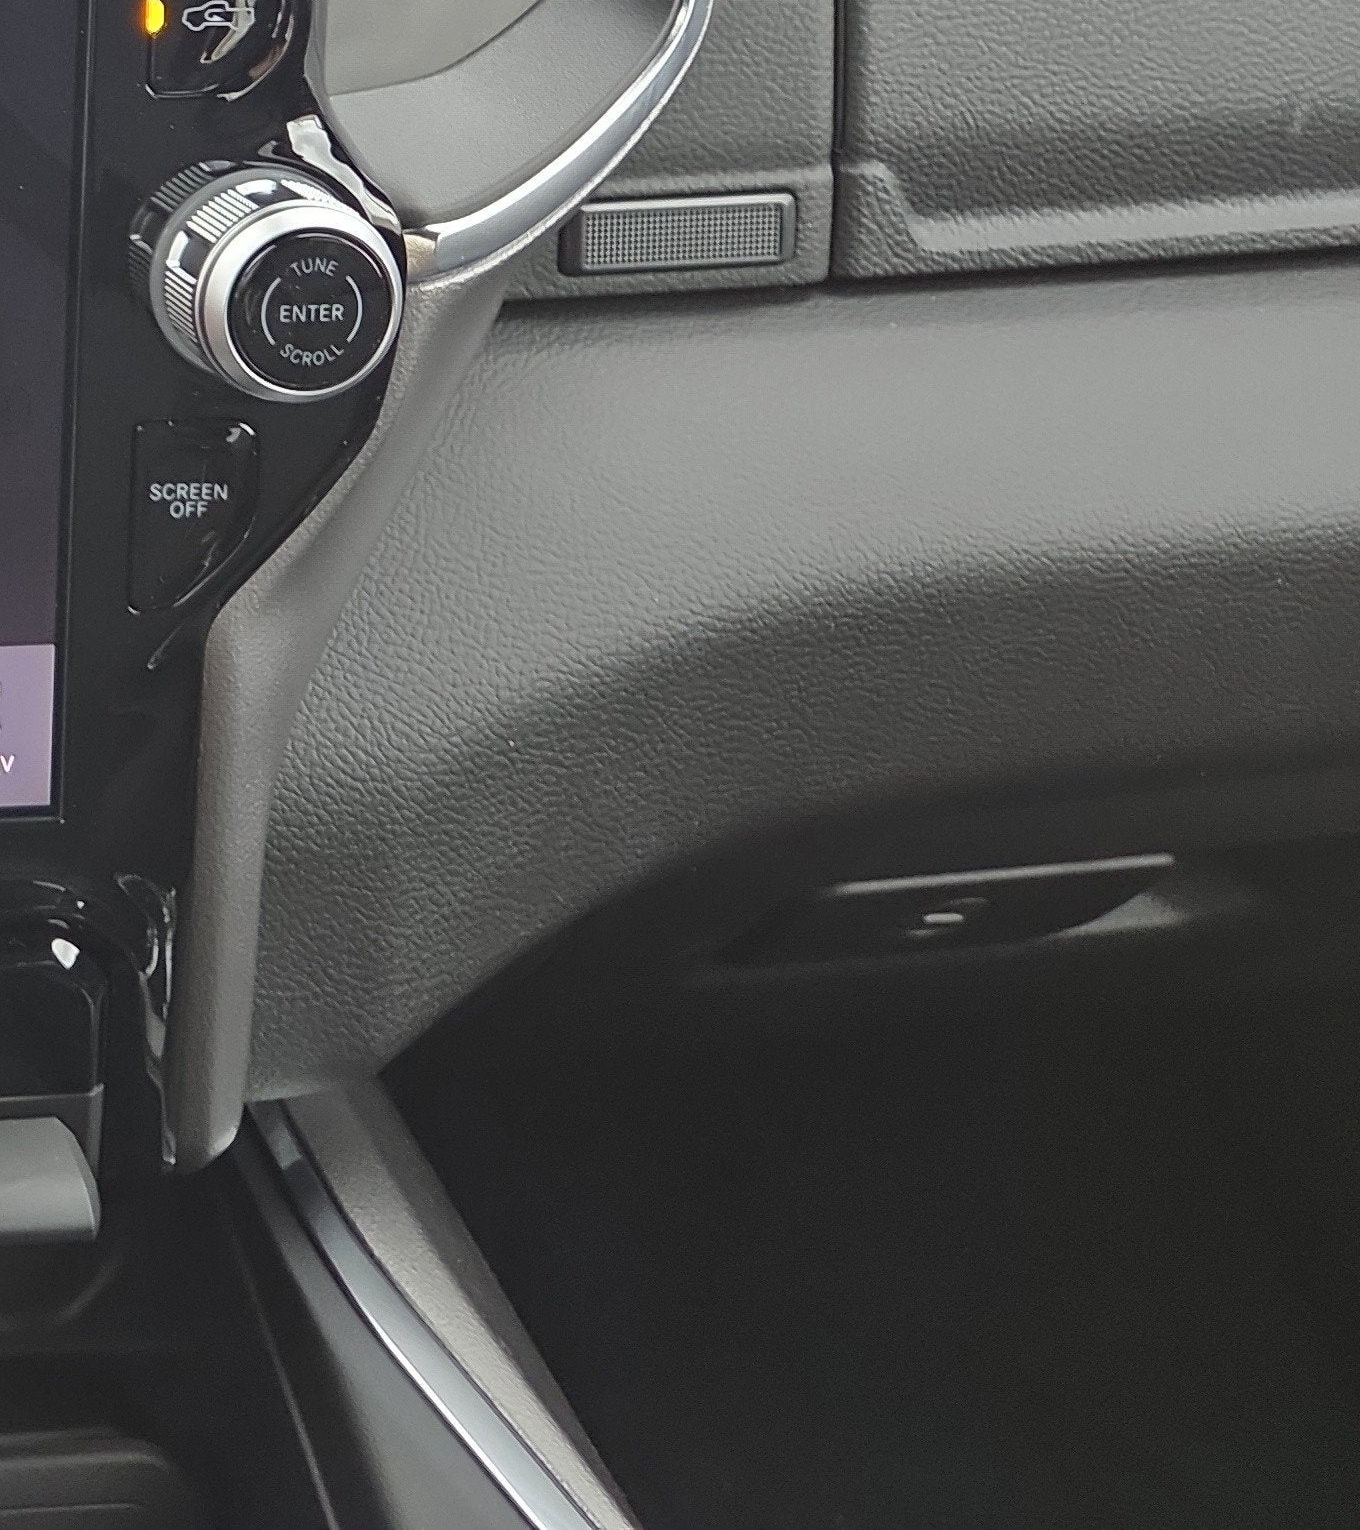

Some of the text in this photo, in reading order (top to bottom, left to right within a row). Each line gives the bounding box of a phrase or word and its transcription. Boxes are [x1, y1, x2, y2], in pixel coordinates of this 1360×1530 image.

[290, 257, 339, 277] TUNE
[279, 303, 345, 323] ENTER
[280, 343, 345, 367] SCROLL
[149, 483, 228, 501] SCREEN
[169, 501, 208, 520] OFF
